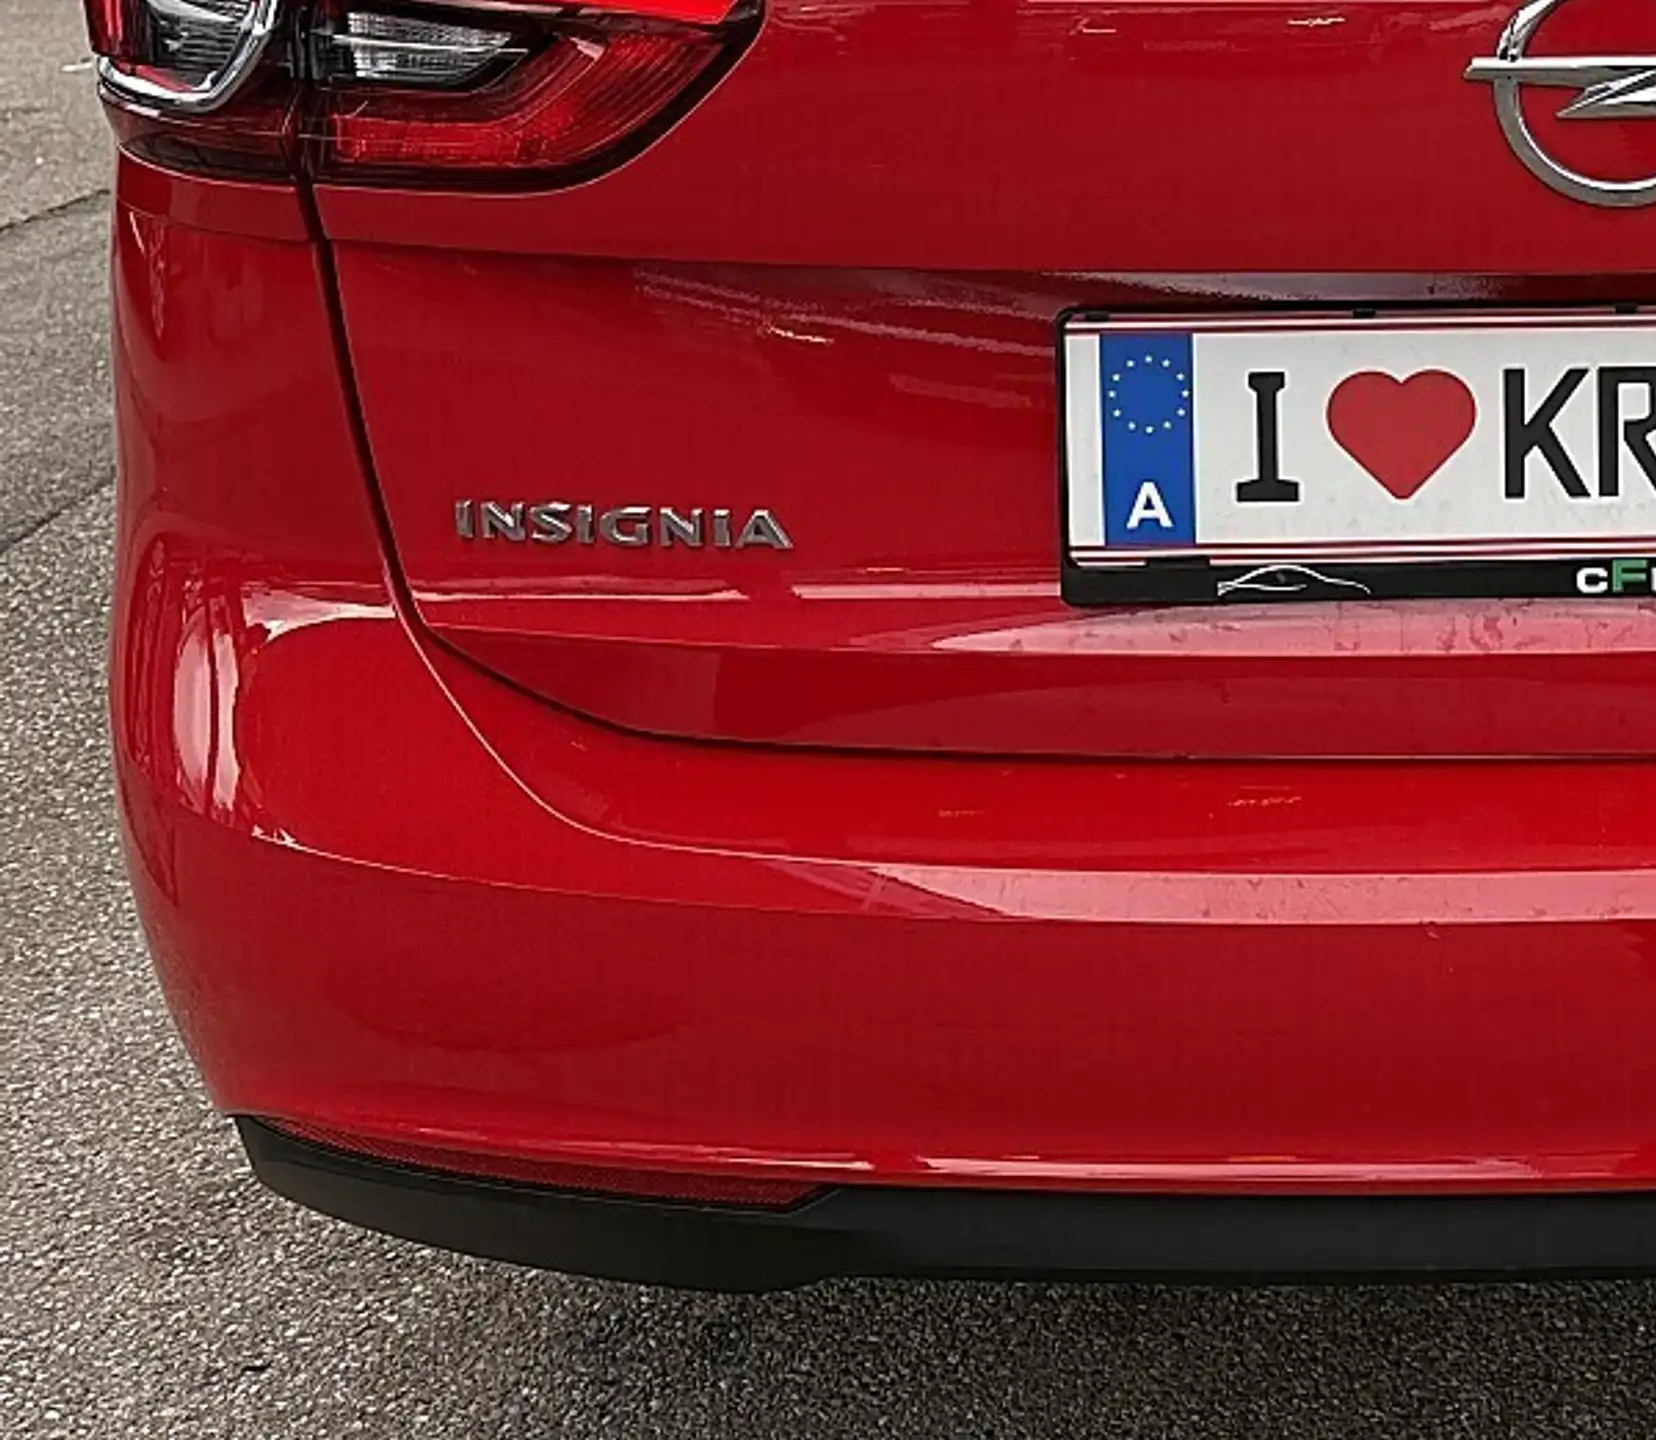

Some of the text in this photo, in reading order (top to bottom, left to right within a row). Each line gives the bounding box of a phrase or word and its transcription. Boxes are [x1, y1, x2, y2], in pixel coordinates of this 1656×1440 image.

[1236, 371, 1300, 503] I
[455, 499, 794, 550] INSIGNIA
[1126, 481, 1174, 530] A
